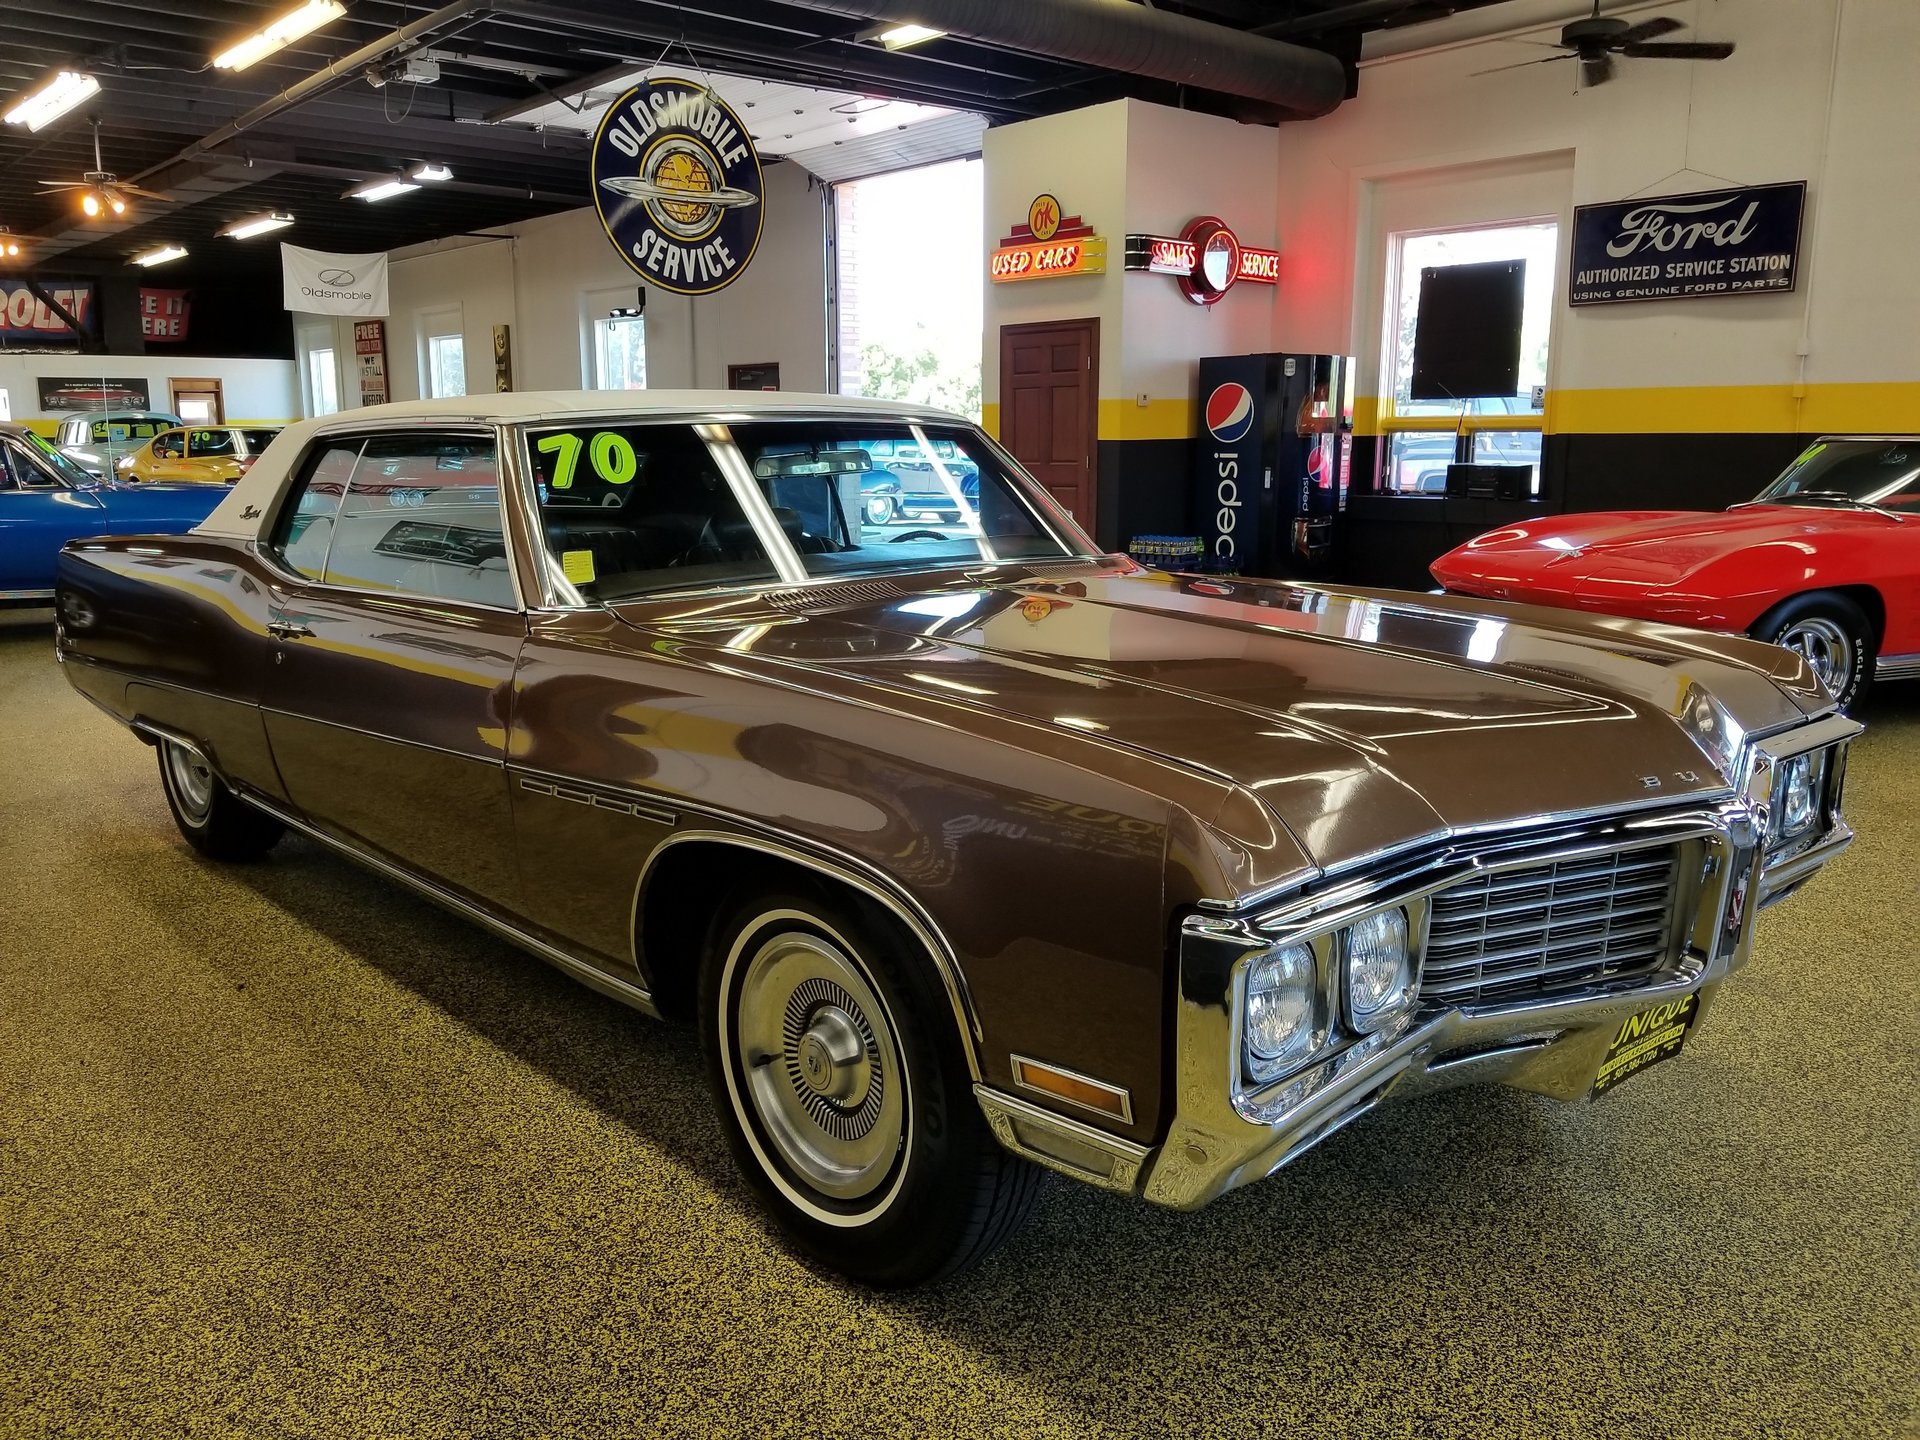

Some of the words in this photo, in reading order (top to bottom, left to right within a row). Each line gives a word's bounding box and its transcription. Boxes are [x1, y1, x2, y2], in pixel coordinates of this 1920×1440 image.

[608, 90, 749, 169] OLDSMOBILE
[1033, 201, 1056, 232] OK
[1606, 194, 1760, 258] Ford
[632, 228, 737, 283] SERVICE
[992, 251, 1033, 275] USED
[1034, 246, 1080, 271] CARS
[1152, 242, 1196, 269] SALES
[1241, 252, 1280, 278] SERVICE
[1576, 264, 1660, 285] AUTHORIZED
[1665, 259, 1725, 279] SERVICE
[1729, 254, 1791, 273] STATION
[301, 286, 372, 300] Oldsmobile
[1573, 290, 1612, 300] USING
[1616, 286, 1680, 298] GENUINE
[1684, 282, 1728, 293] FORD
[1731, 277, 1790, 289] PARTS
[142, 316, 180, 336] ERE
[355, 323, 380, 340] FREE
[364, 356, 375, 365] WE
[192, 431, 211, 443] 70
[538, 431, 638, 489] 70
[1302, 477, 1310, 512] pepsi
[1855, 638, 1864, 683] EAGLE
